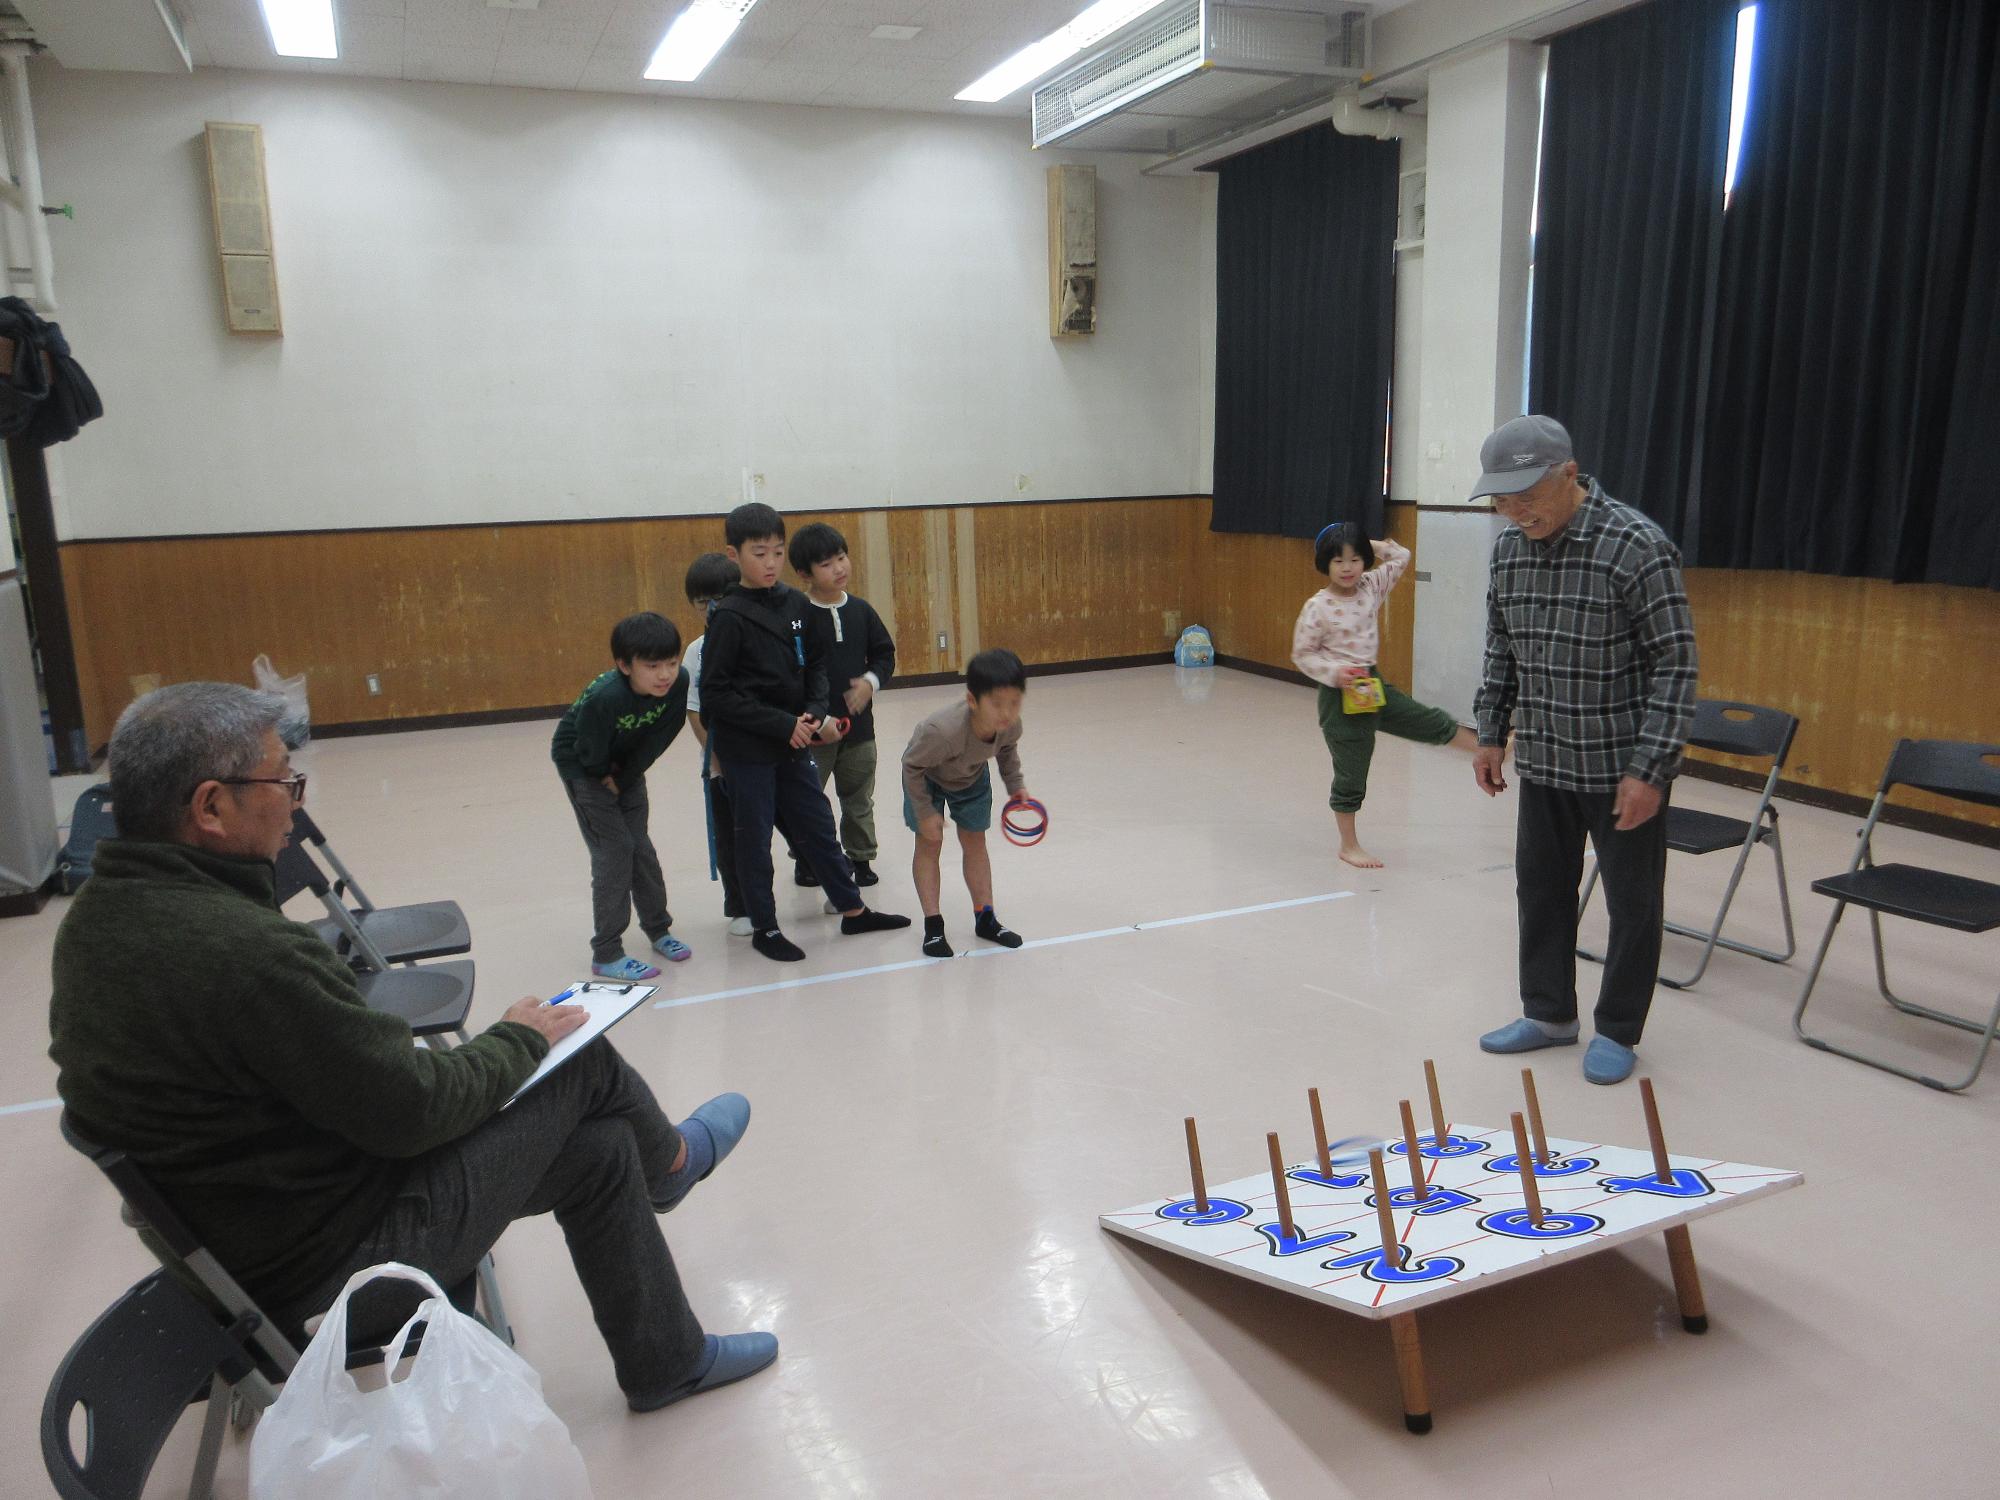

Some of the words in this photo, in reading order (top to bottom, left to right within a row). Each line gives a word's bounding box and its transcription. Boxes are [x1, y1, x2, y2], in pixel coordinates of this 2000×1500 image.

[1386, 1134, 1492, 1159] 8
[1285, 1169, 1370, 1189] 1
[1597, 1168, 1716, 1199] 4
[1363, 1184, 1482, 1216] 5
[1254, 1221, 1357, 1257] 7
[1320, 1243, 1466, 1283] 2
